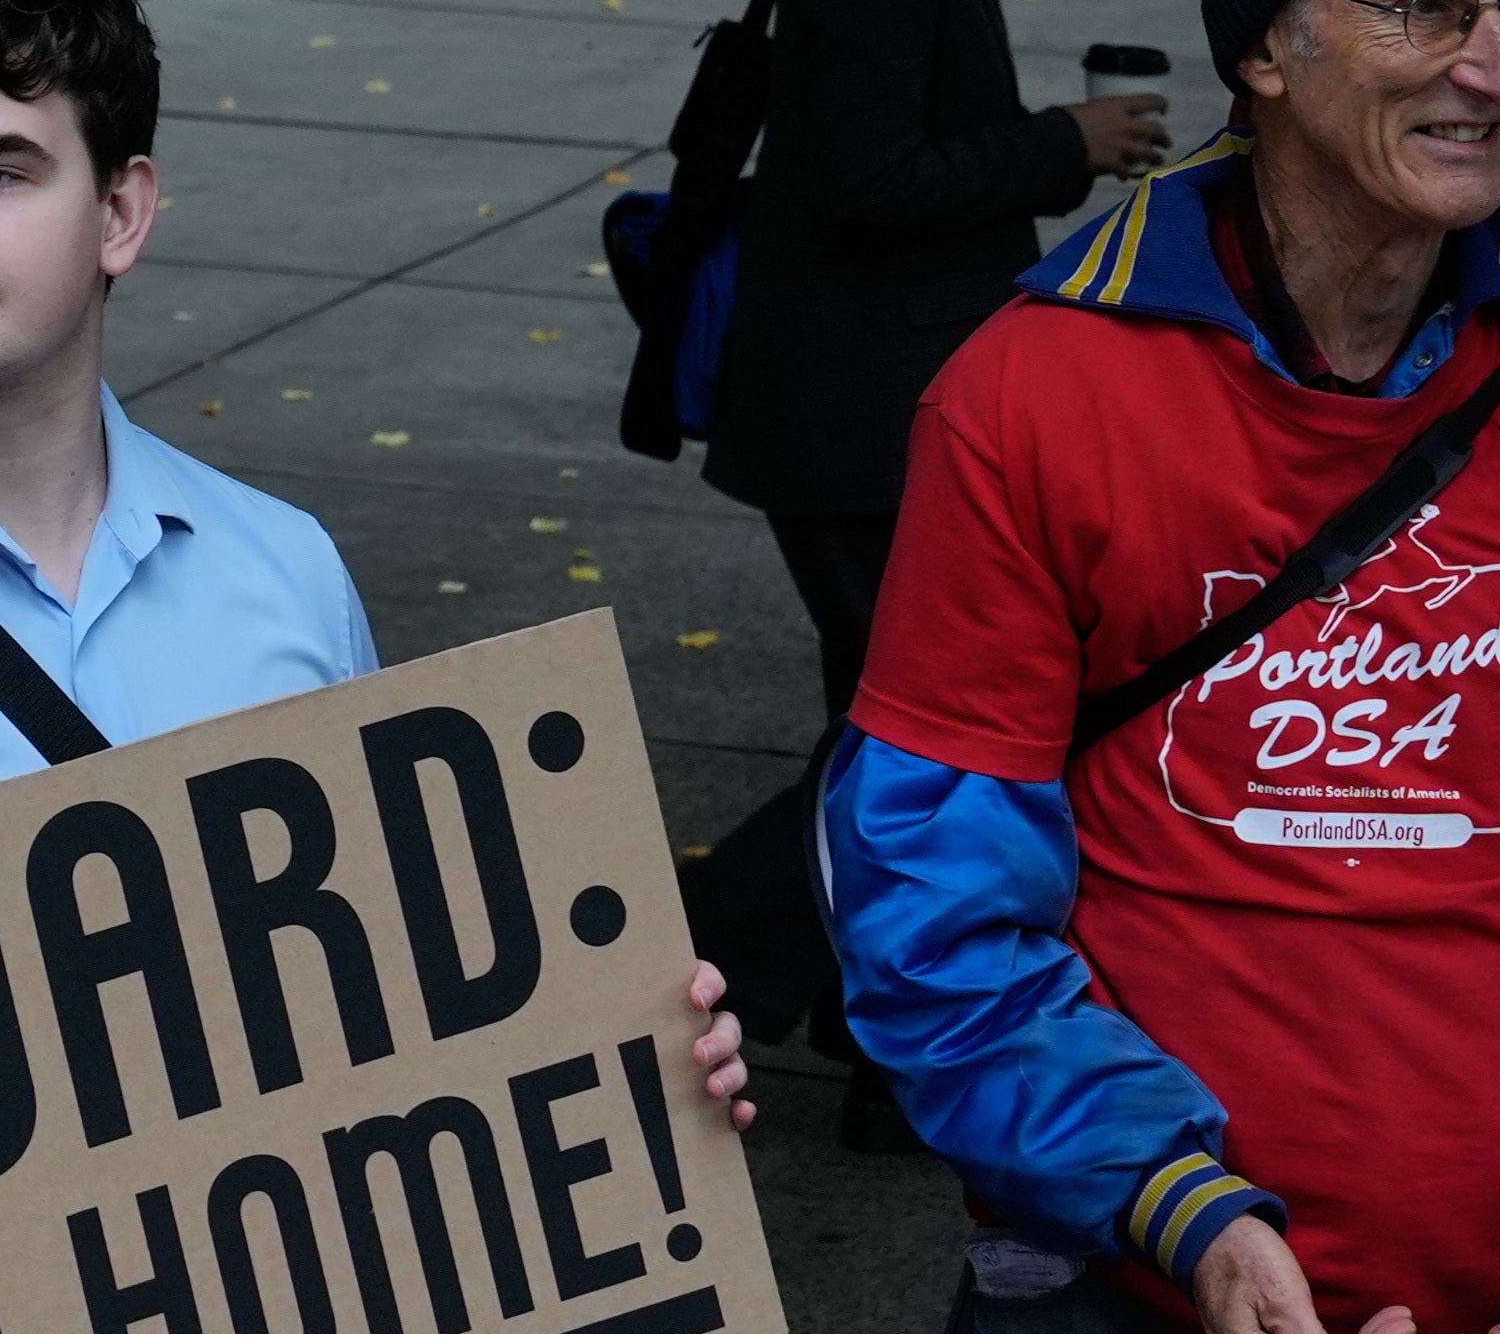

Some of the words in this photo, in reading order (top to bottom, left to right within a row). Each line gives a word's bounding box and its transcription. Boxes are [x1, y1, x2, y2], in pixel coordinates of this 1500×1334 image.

[1249, 693, 1462, 770] DSA
[1247, 781, 1323, 798] Democratic
[1325, 785, 1389, 799] Socialists
[1391, 787, 1405, 799] of
[1407, 787, 1460, 800] America
[1282, 817, 1424, 847] PortlandDSA.org
